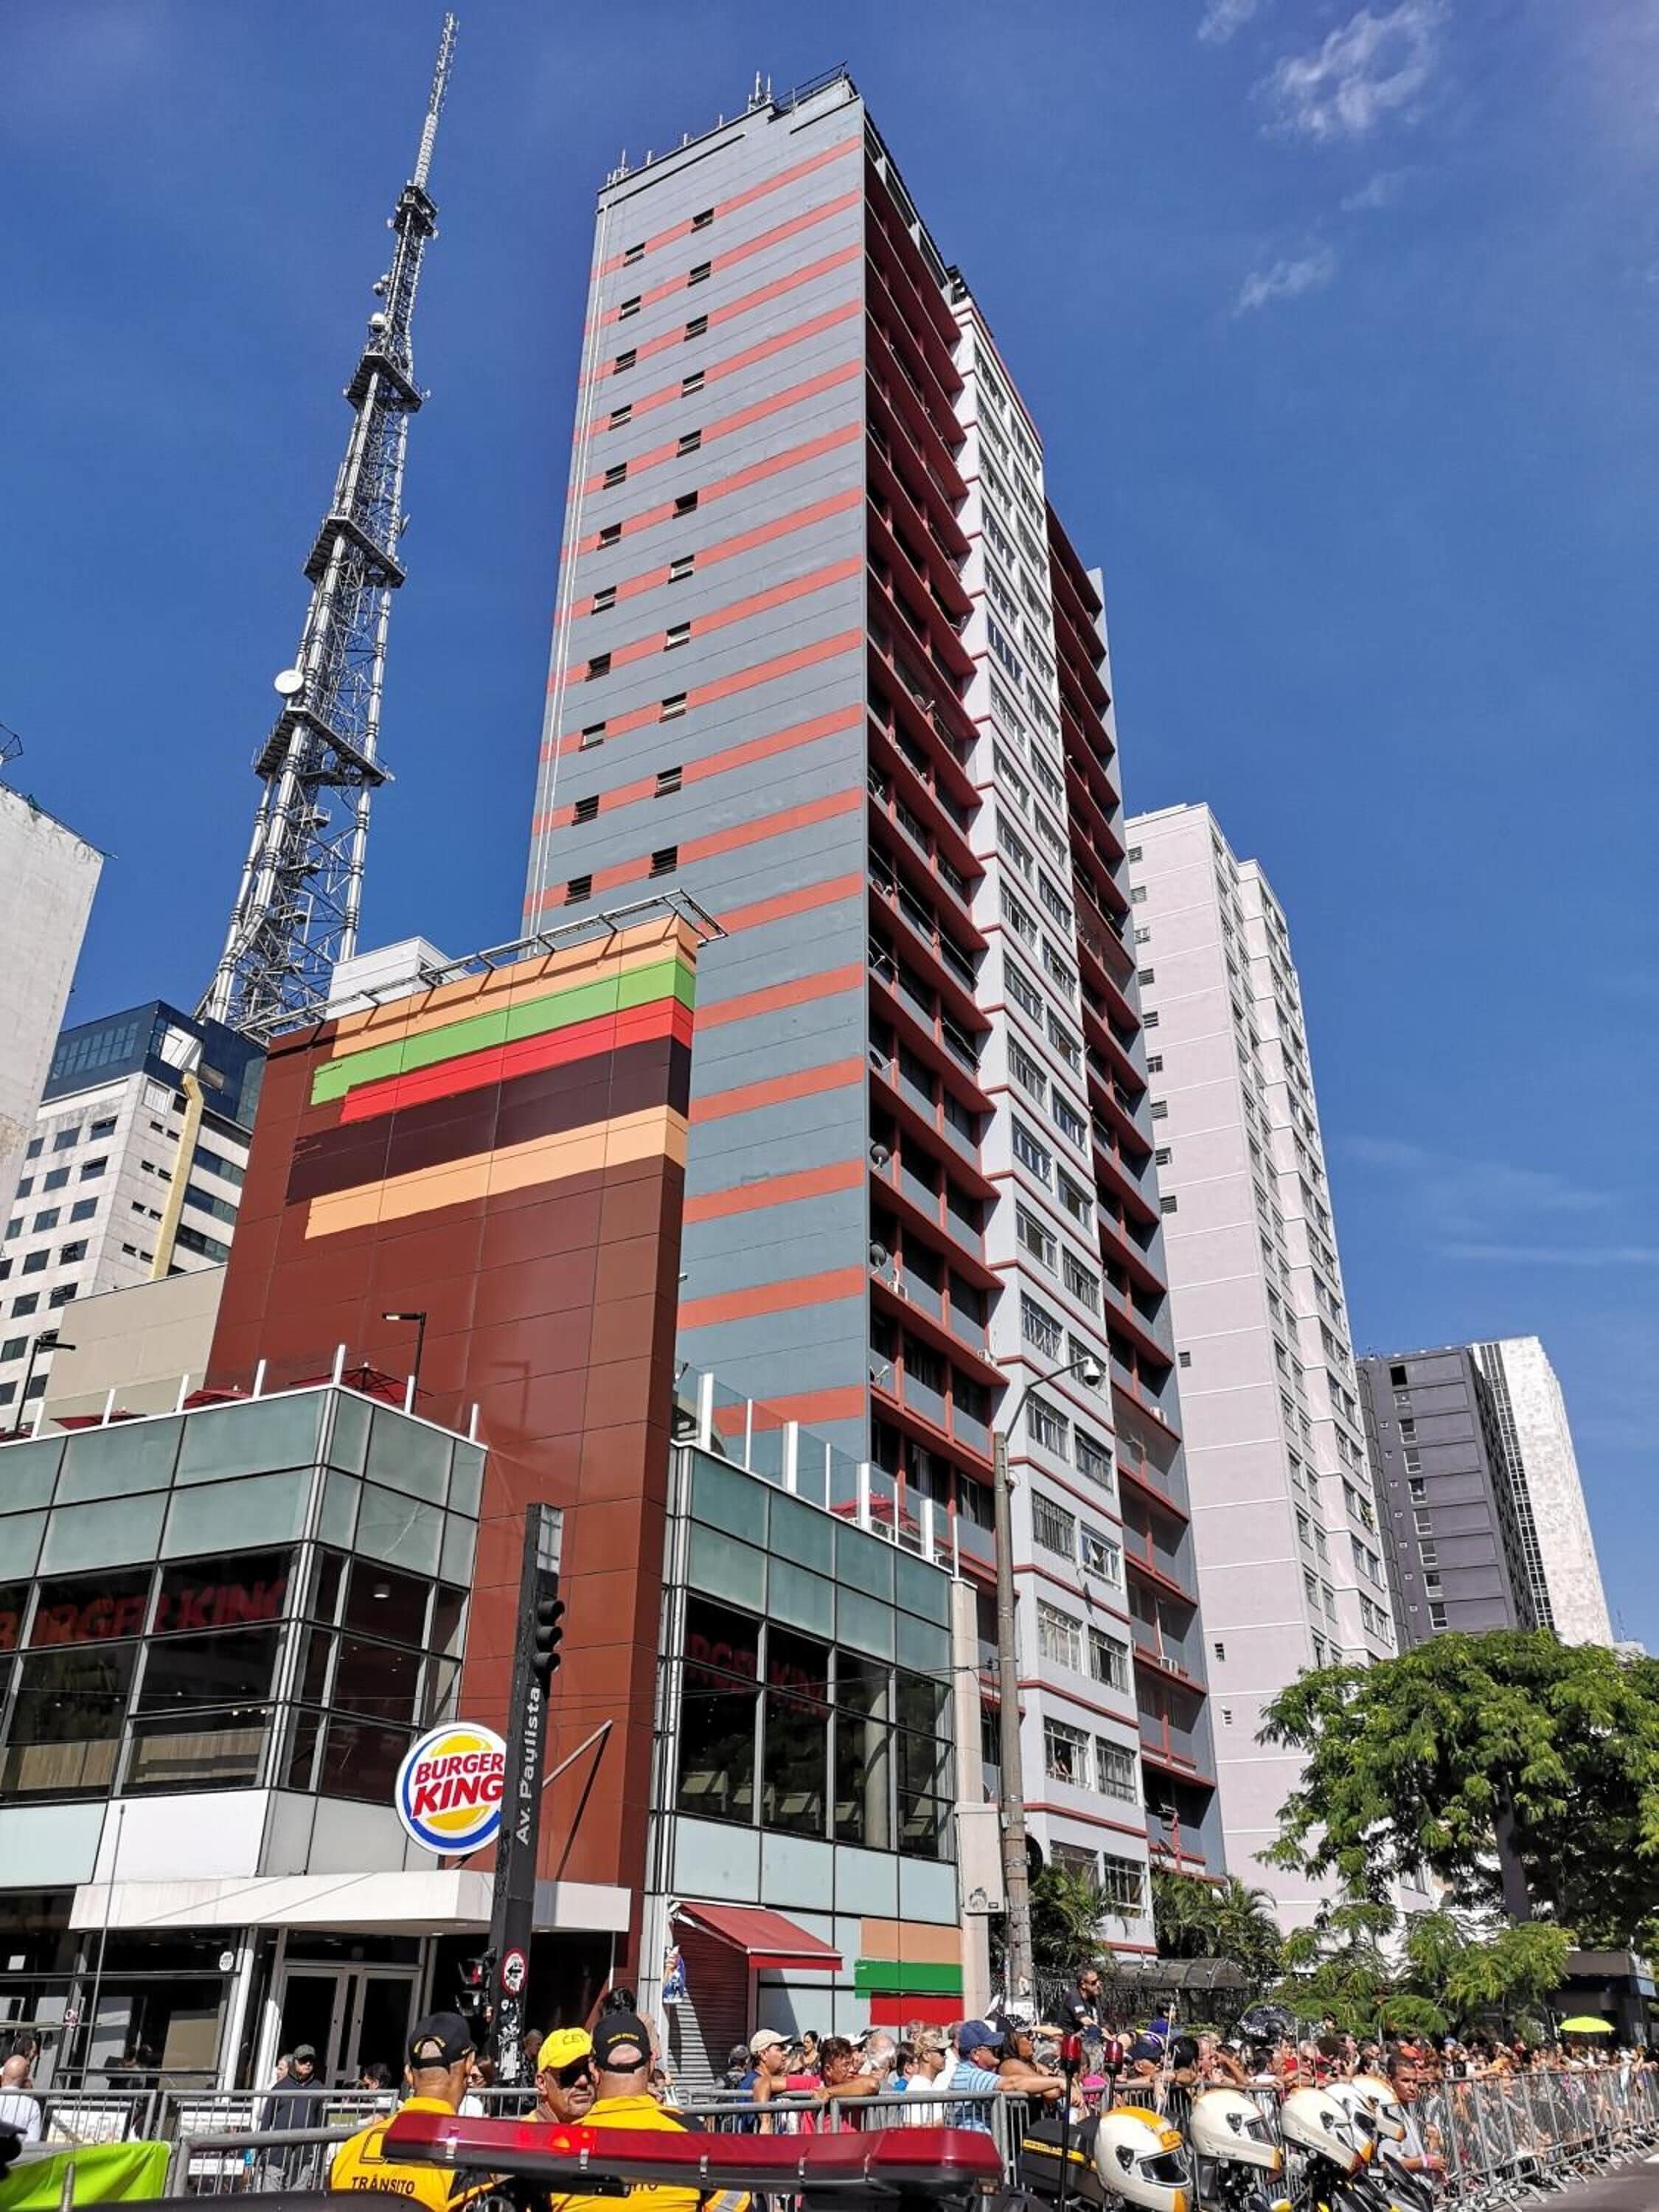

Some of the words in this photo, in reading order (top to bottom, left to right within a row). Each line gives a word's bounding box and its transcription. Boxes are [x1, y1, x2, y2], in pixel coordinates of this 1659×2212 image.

[414, 1752, 505, 1786] BURGER
[412, 1773, 505, 1817] KING
[515, 1806, 531, 1846] Av.
